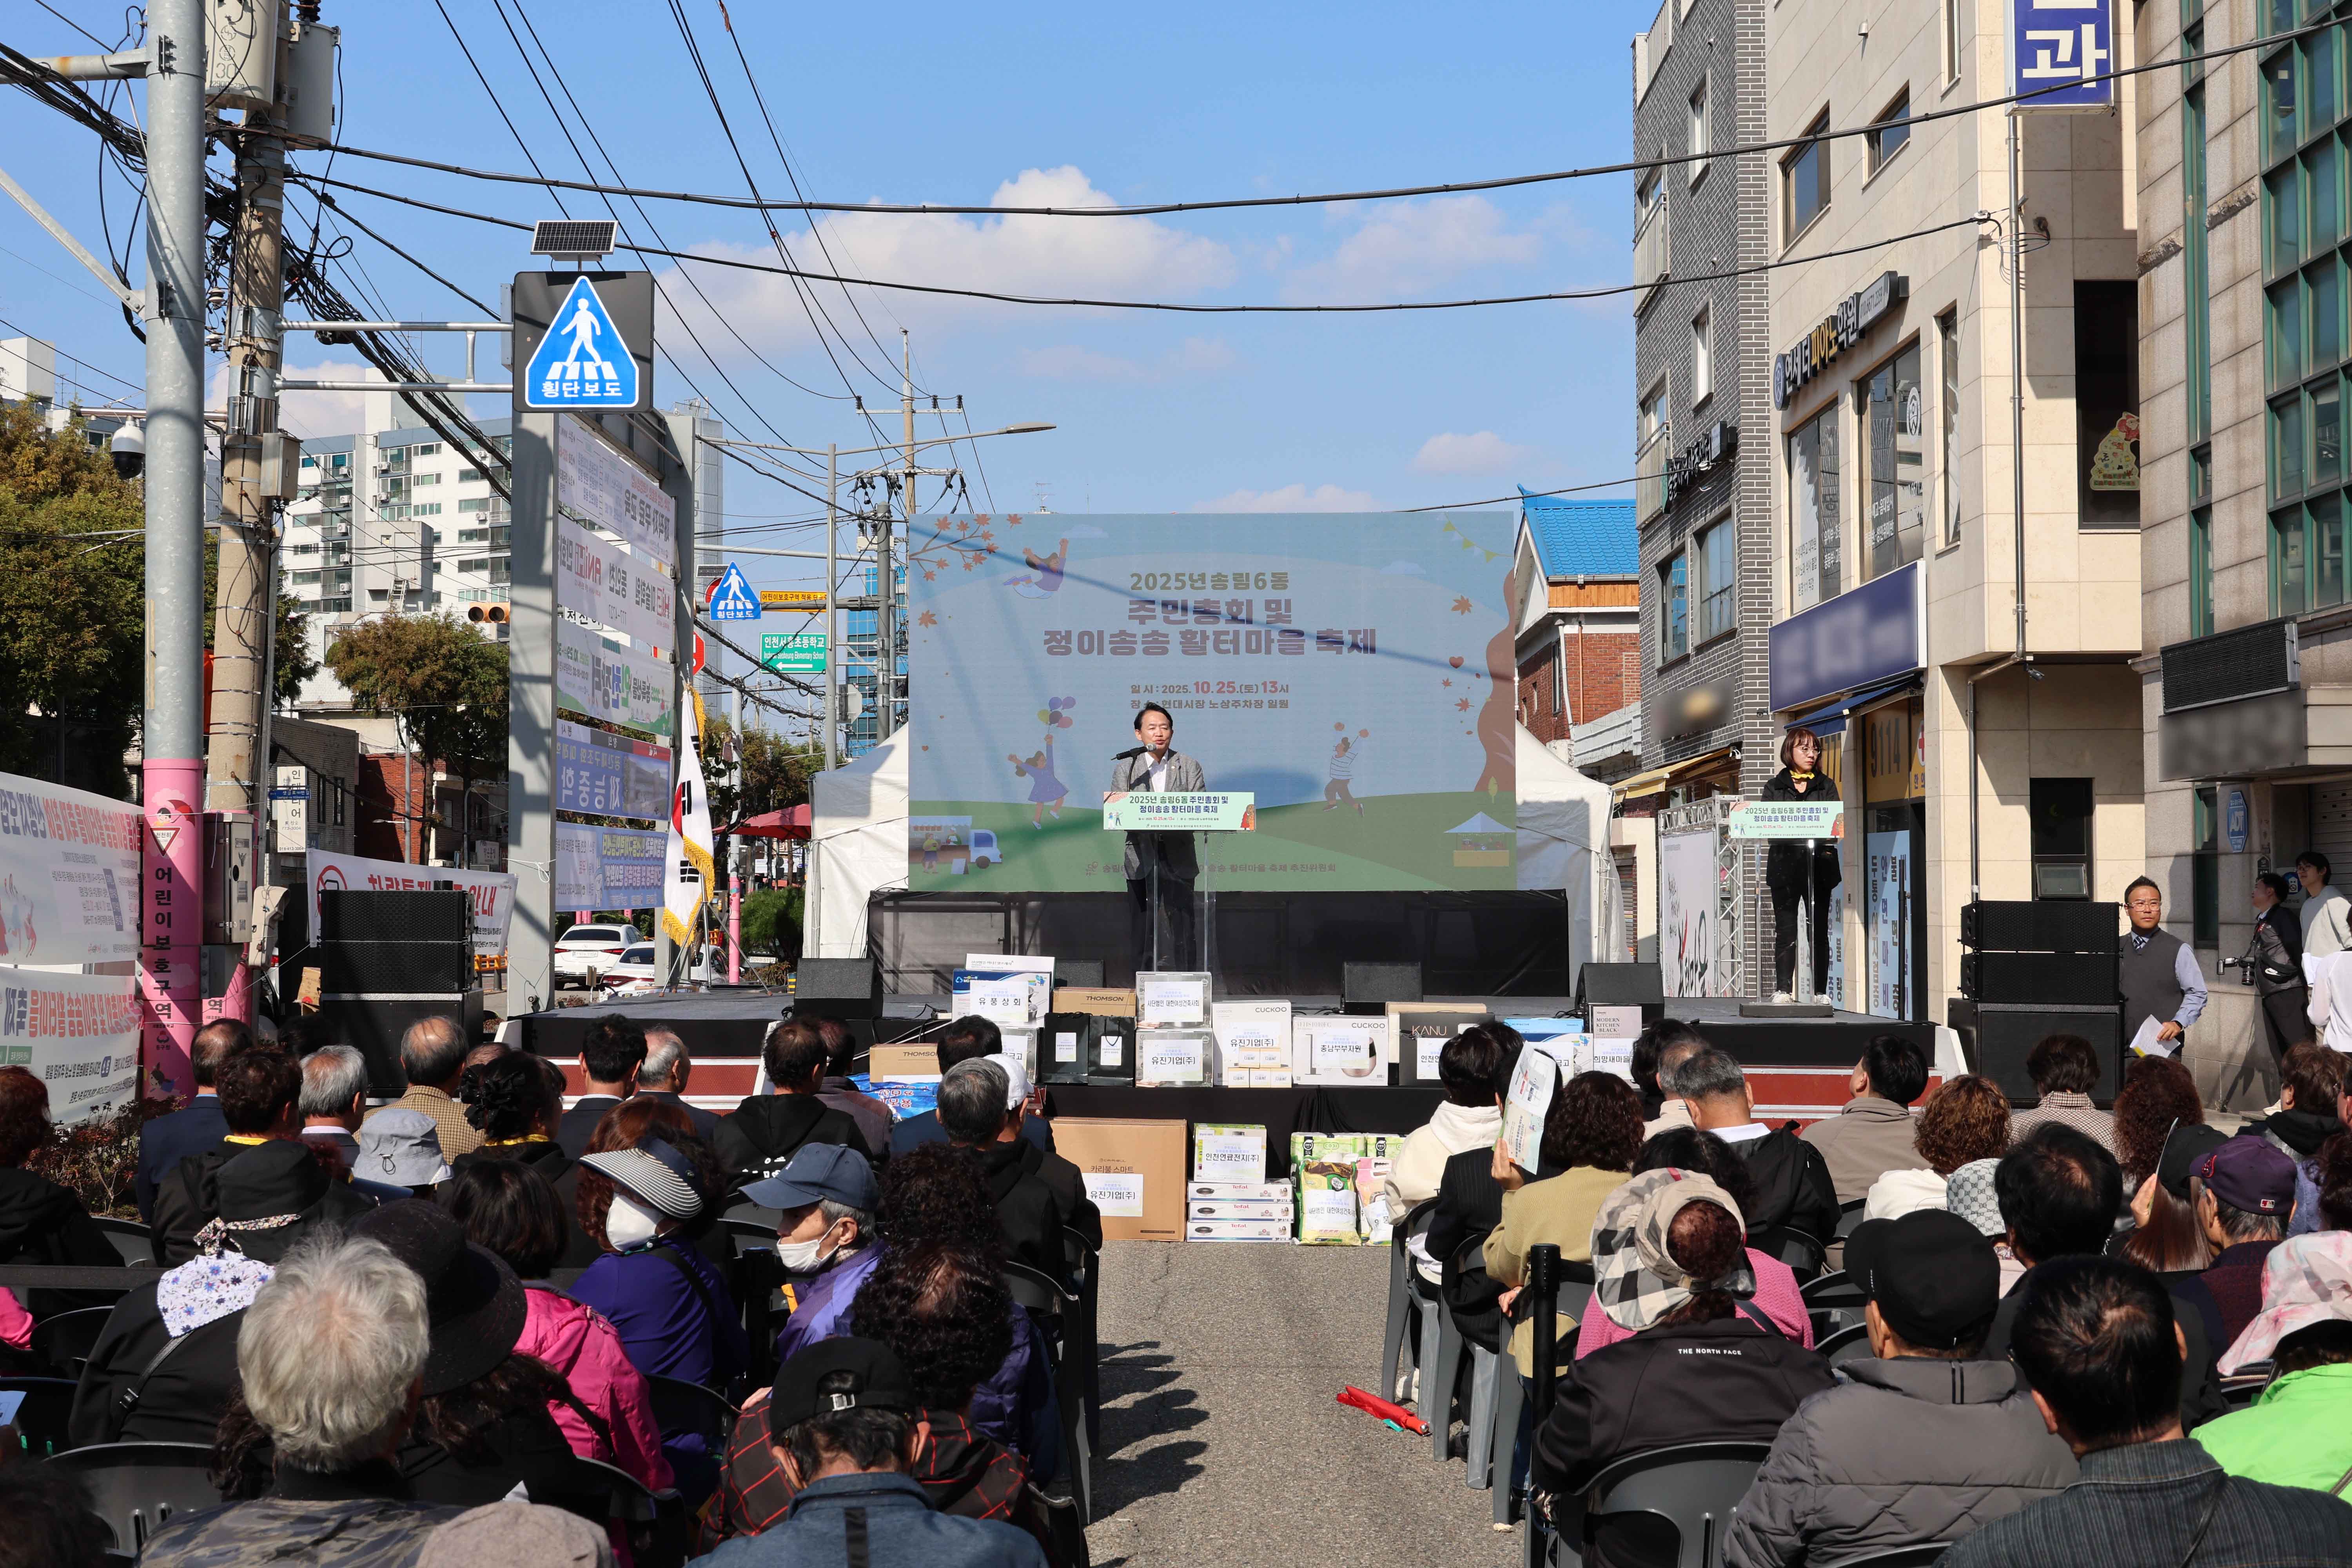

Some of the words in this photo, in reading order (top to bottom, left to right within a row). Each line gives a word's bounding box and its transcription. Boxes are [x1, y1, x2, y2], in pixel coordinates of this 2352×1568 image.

[2023, 0, 2107, 87] 과
[541, 381, 622, 397] 횡단보도
[1130, 572, 1206, 591] 2025년
[1210, 572, 1289, 591] 송림6동
[1128, 598, 1253, 625] 주민총회
[1265, 599, 1292, 625] 및
[1044, 629, 1170, 656] 정이송송
[1180, 629, 1306, 656] 활터마을
[1316, 628, 1377, 655] 축제
[1161, 685, 1192, 694] 2025.
[1261, 681, 1289, 694] 13시
[1161, 700, 1205, 708] 현대시장
[1209, 699, 1264, 709] 노상주차장
[1268, 699, 1289, 708] 일원
[1871, 718, 1901, 778] 9114
[1190, 796, 1220, 804] 주민총회
[1172, 805, 1202, 813] 활터마을
[2229, 811, 2244, 832] ADT
[1269, 864, 1287, 873] 축제
[1289, 864, 1336, 873] 추진위원회
[153, 867, 172, 1019] 어린이보호구역
[209, 999, 222, 1013] 역
[1412, 1025, 1447, 1036] KANU
[1230, 1039, 1274, 1047] 유진기업(주)
[1152, 1056, 1195, 1065] 유진기업(주)
[1206, 1153, 1259, 1162] 인천연료전지(주)
[1091, 1191, 1135, 1200] 유진기업(주)
